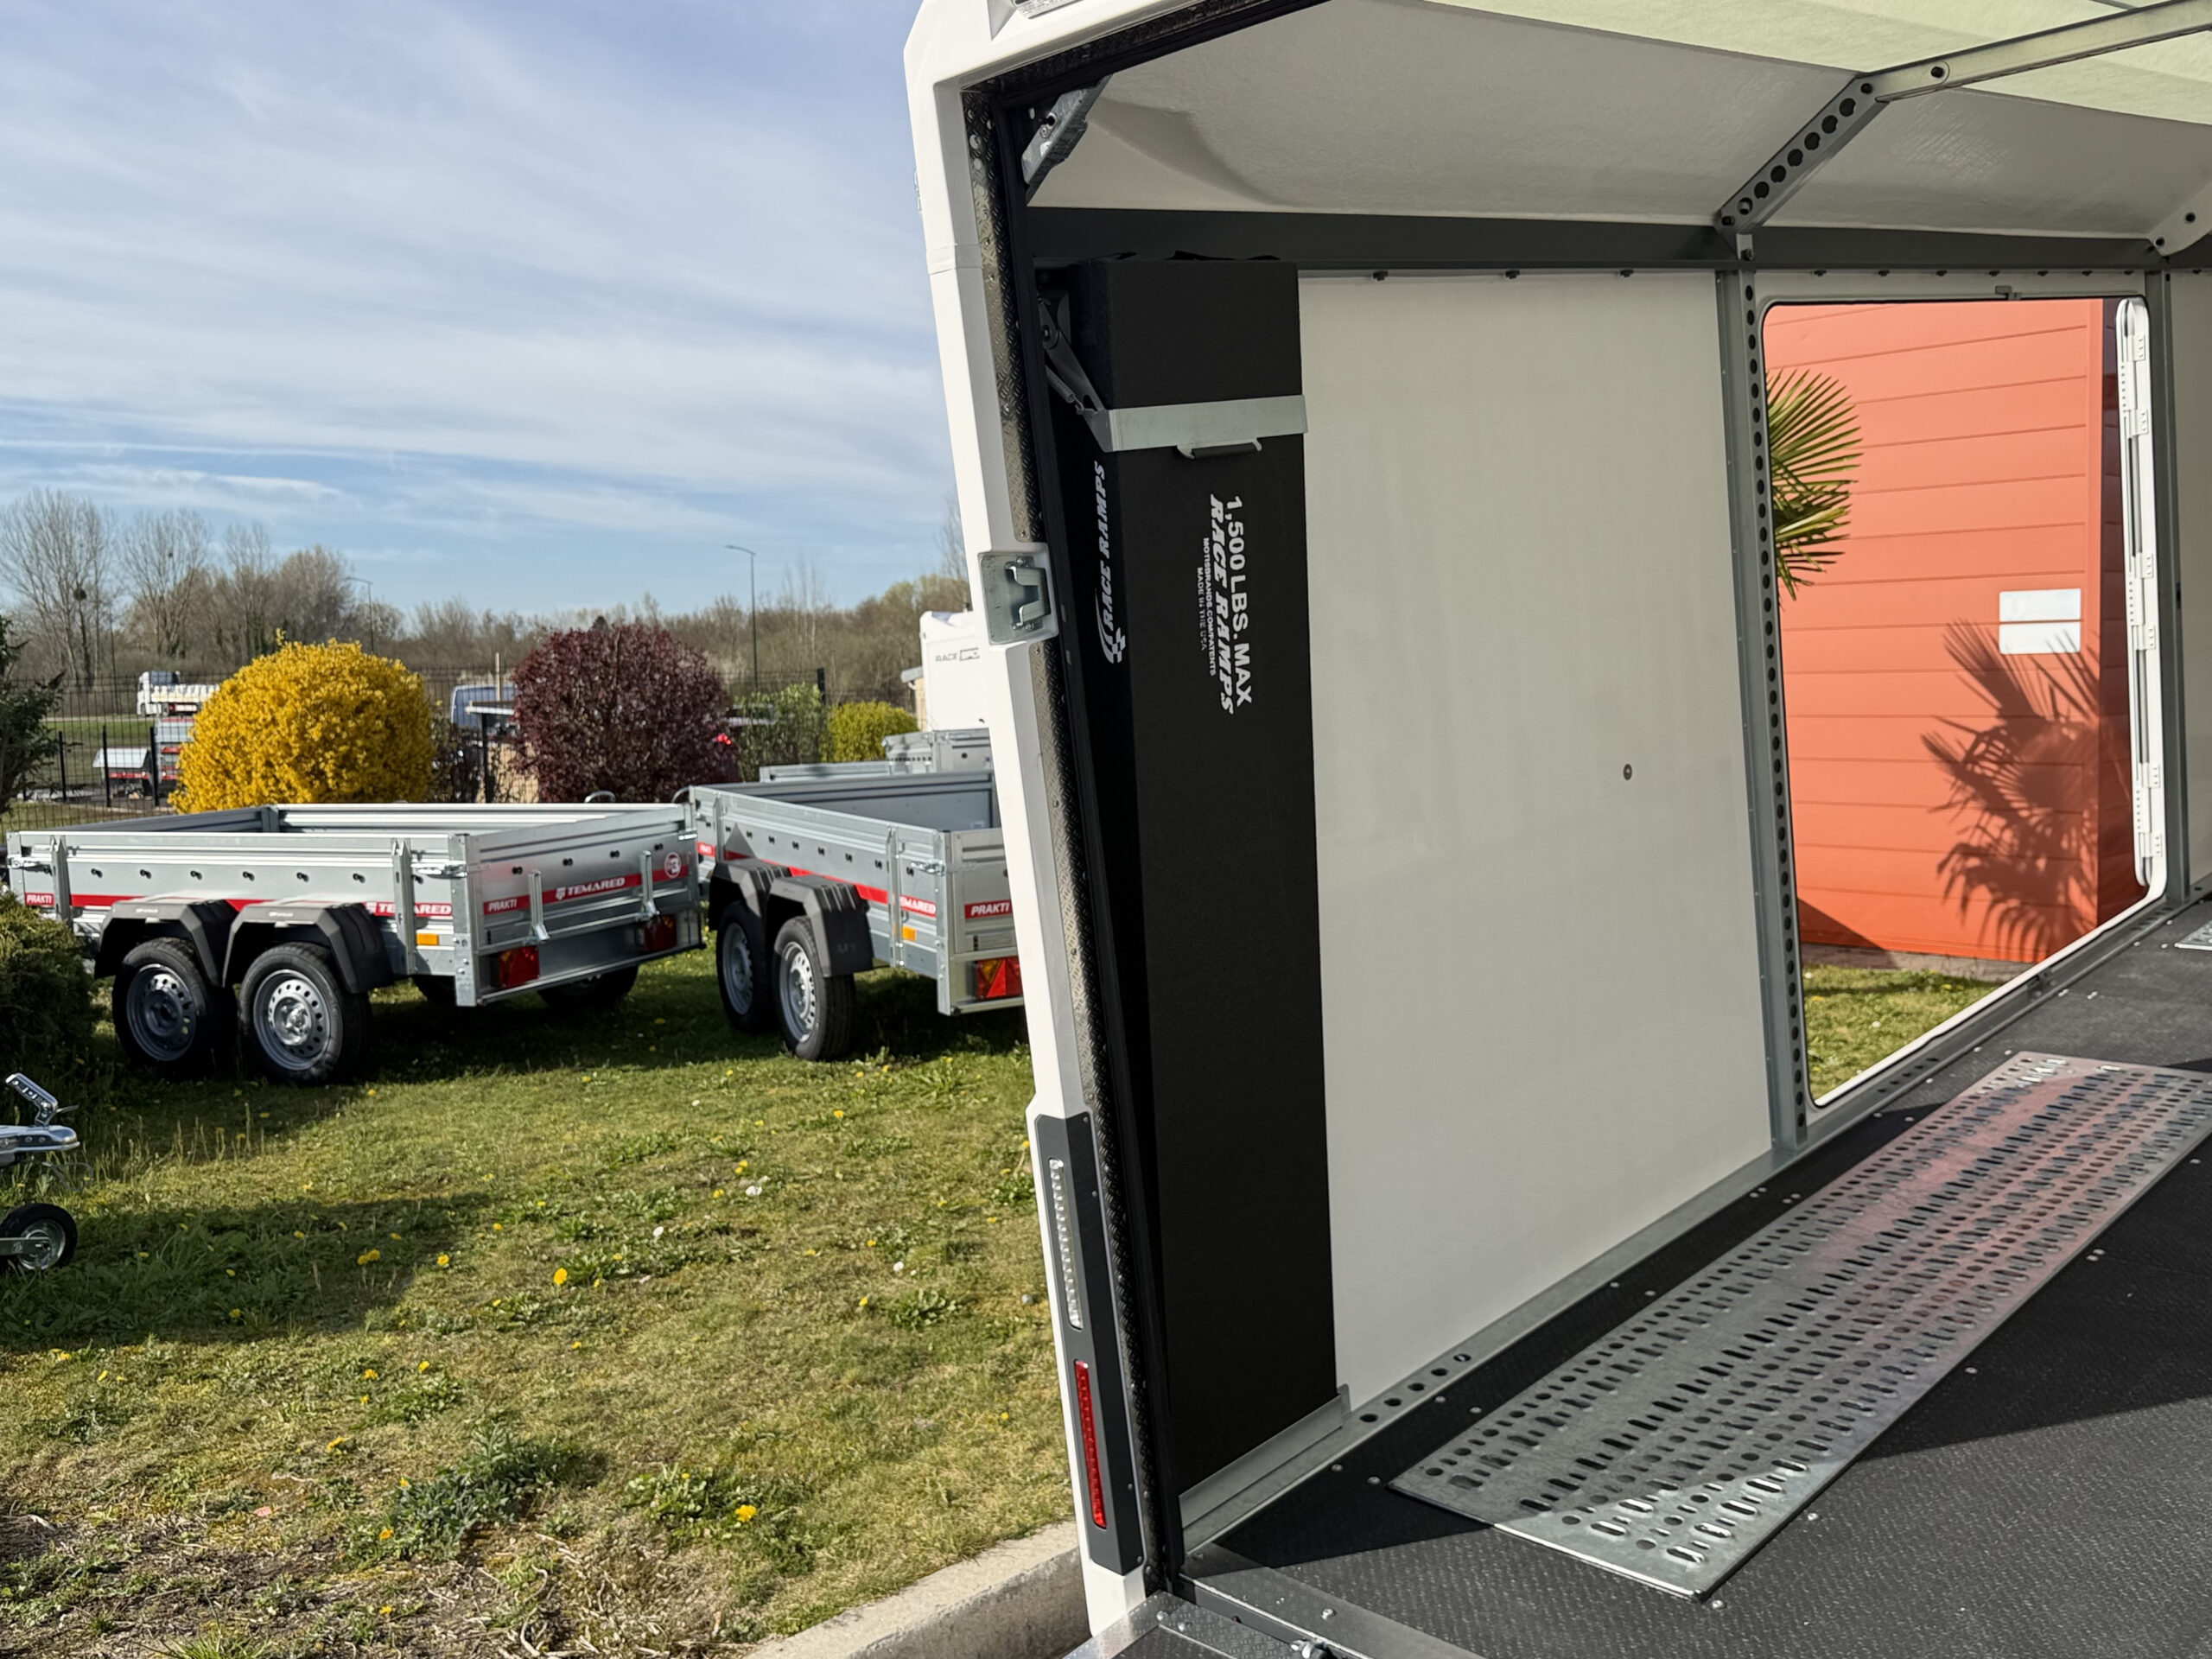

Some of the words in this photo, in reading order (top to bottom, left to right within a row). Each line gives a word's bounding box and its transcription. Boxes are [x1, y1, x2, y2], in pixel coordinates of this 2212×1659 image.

[1094, 461, 1110, 559] RAMPS
[1211, 493, 1228, 589] RACE
[1225, 496, 1246, 570] 1,500
[1100, 560, 1114, 632] RACE
[1197, 567, 1205, 595] MADE
[1230, 575, 1249, 640] LBS.
[1216, 591, 1234, 715] RAMPS
[1234, 642, 1252, 707] MAX
[27, 893, 53, 905] PRAKTI
[488, 899, 518, 912] PRAKTI
[568, 877, 626, 896] TEMARED
[971, 902, 1010, 916] PRAKTI
